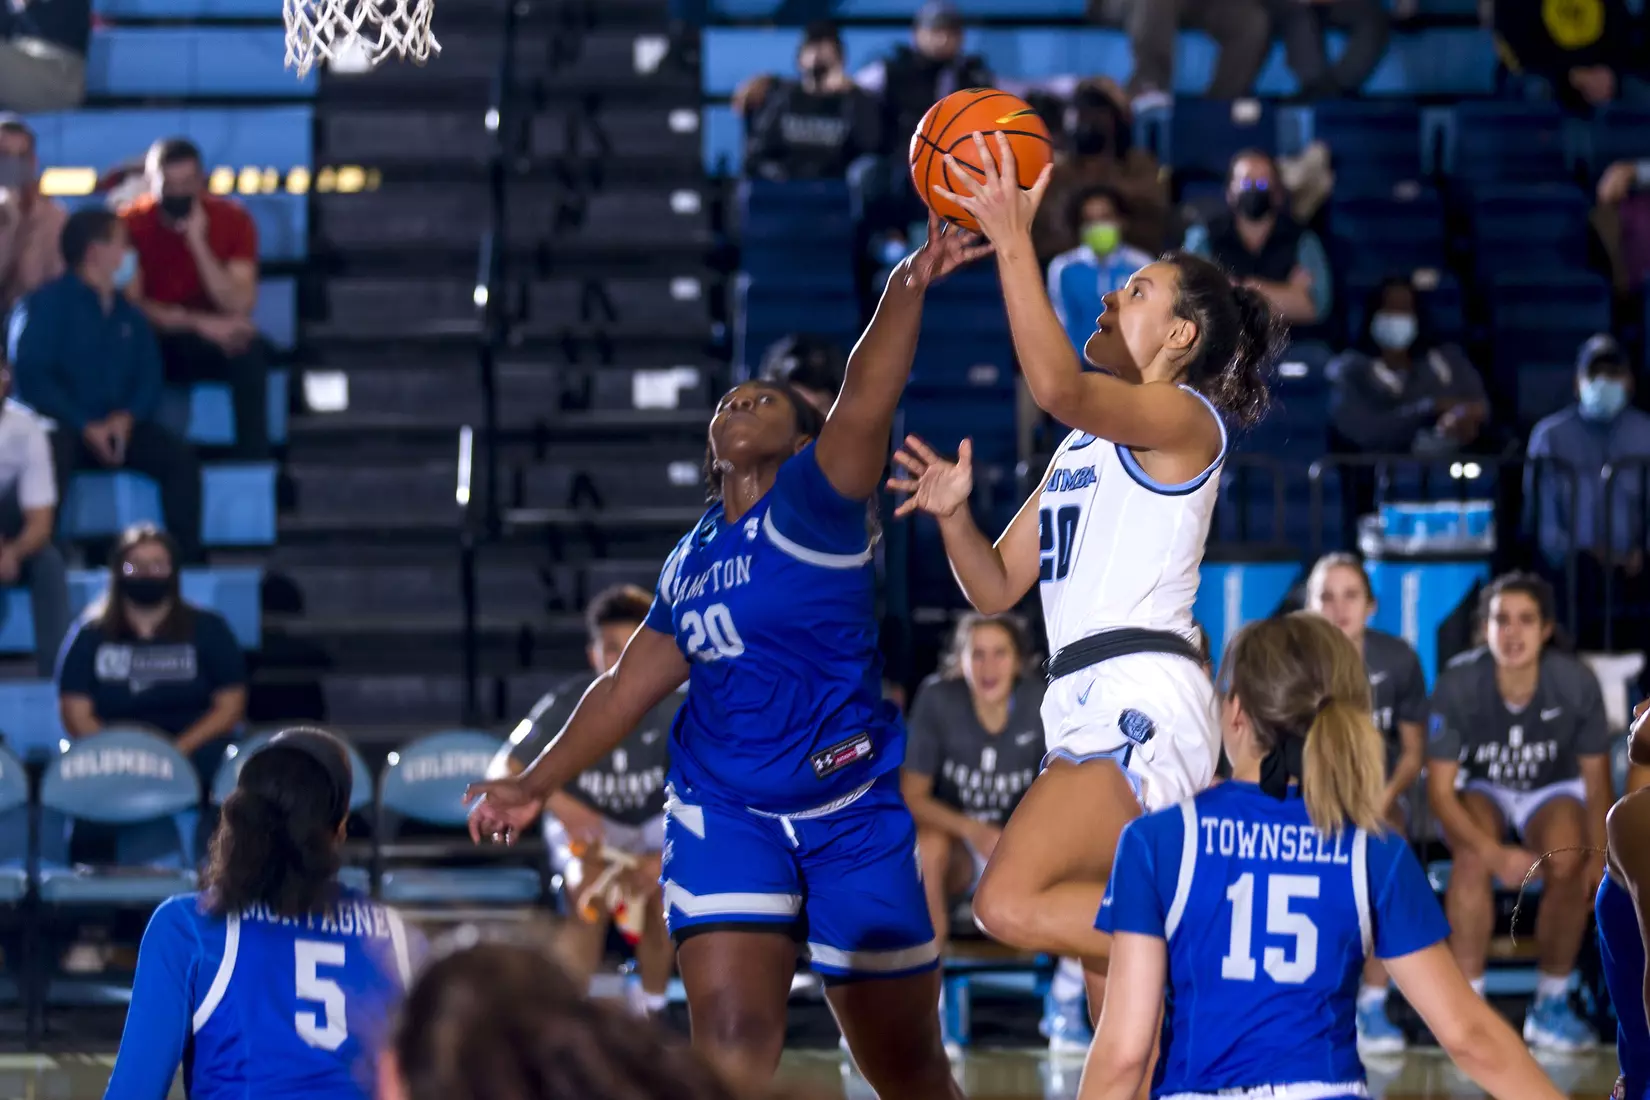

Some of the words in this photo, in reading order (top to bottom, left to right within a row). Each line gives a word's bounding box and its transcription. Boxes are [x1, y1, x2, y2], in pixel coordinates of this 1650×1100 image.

[1039, 505, 1081, 582] 20
[681, 602, 746, 661] 20
[402, 750, 491, 784] COLUMB
[1201, 816, 1349, 864] TOWNSELL
[241, 900, 391, 938] MOTAGNE
[1221, 872, 1320, 984] 15
[294, 938, 348, 1051] 5
